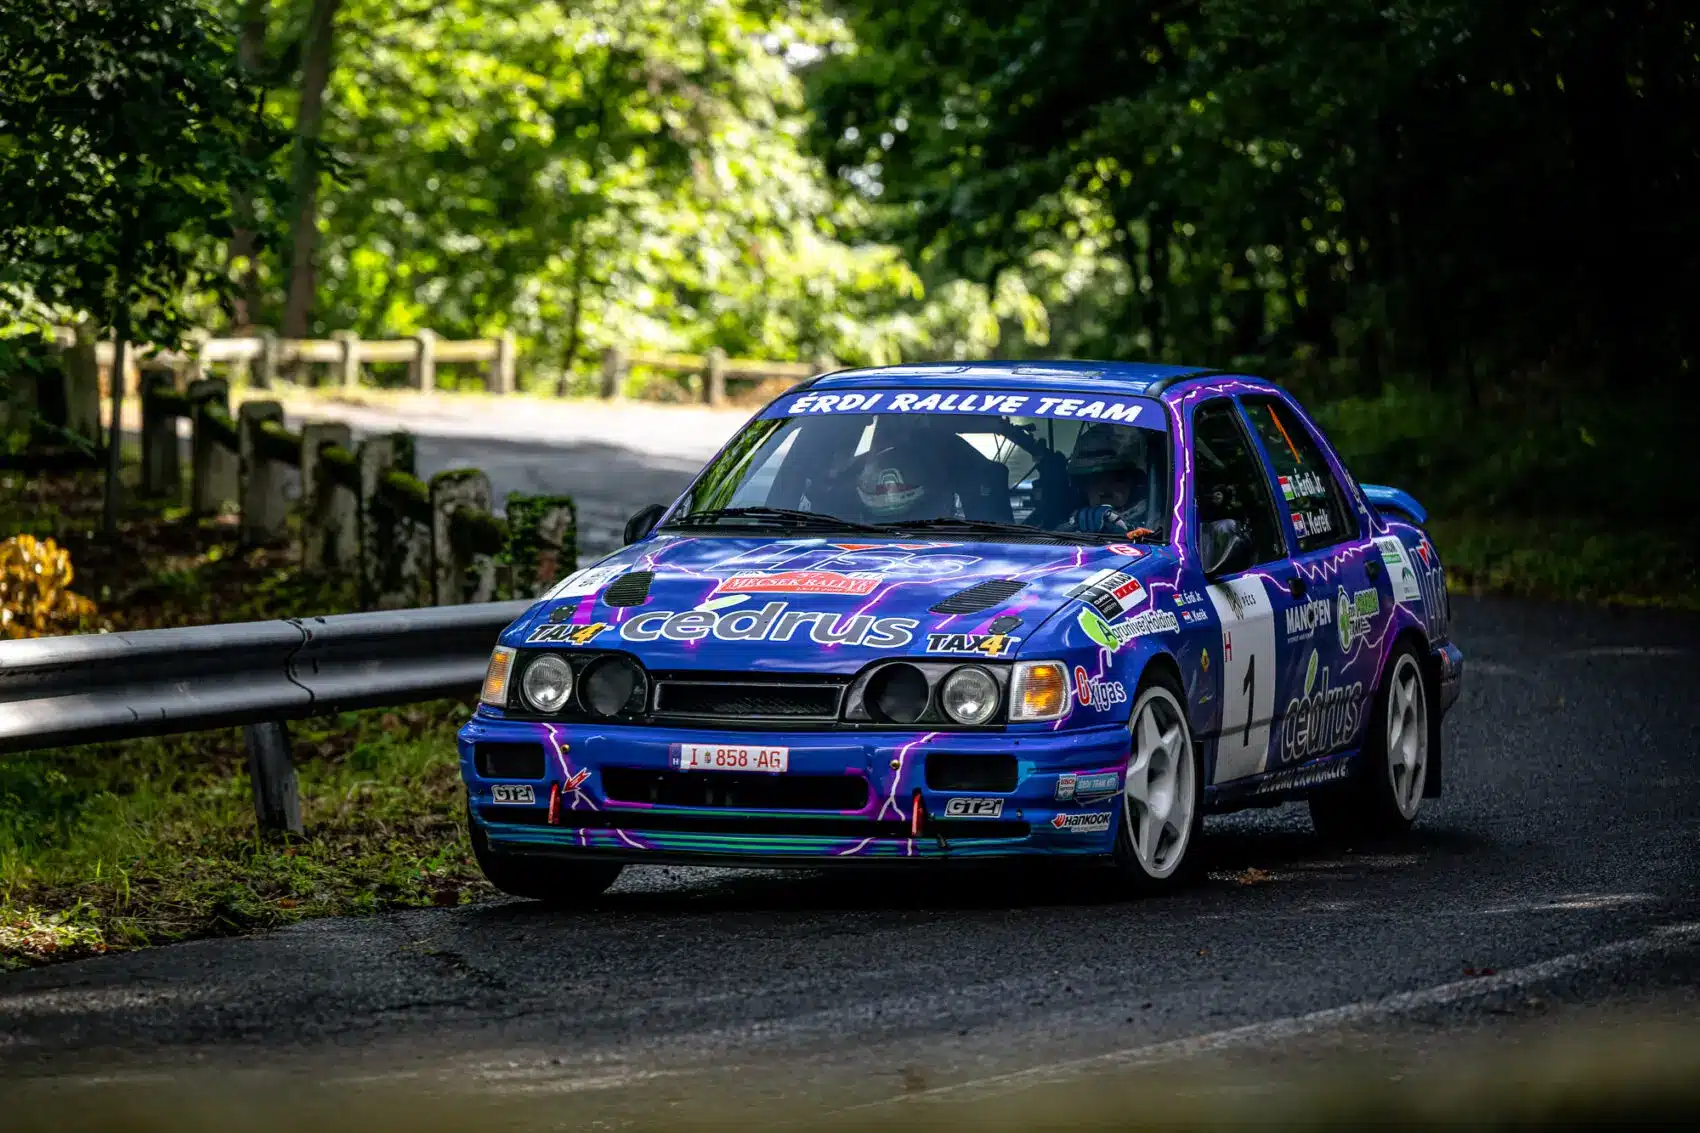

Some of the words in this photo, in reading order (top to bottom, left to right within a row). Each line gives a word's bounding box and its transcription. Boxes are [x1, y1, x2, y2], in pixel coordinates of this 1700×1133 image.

[788, 391, 882, 414] ÉRDI
[887, 393, 1029, 416] RALLYE
[1039, 397, 1143, 422] TEAM
[1223, 631, 1233, 663] H
[1242, 654, 1255, 747] 1
